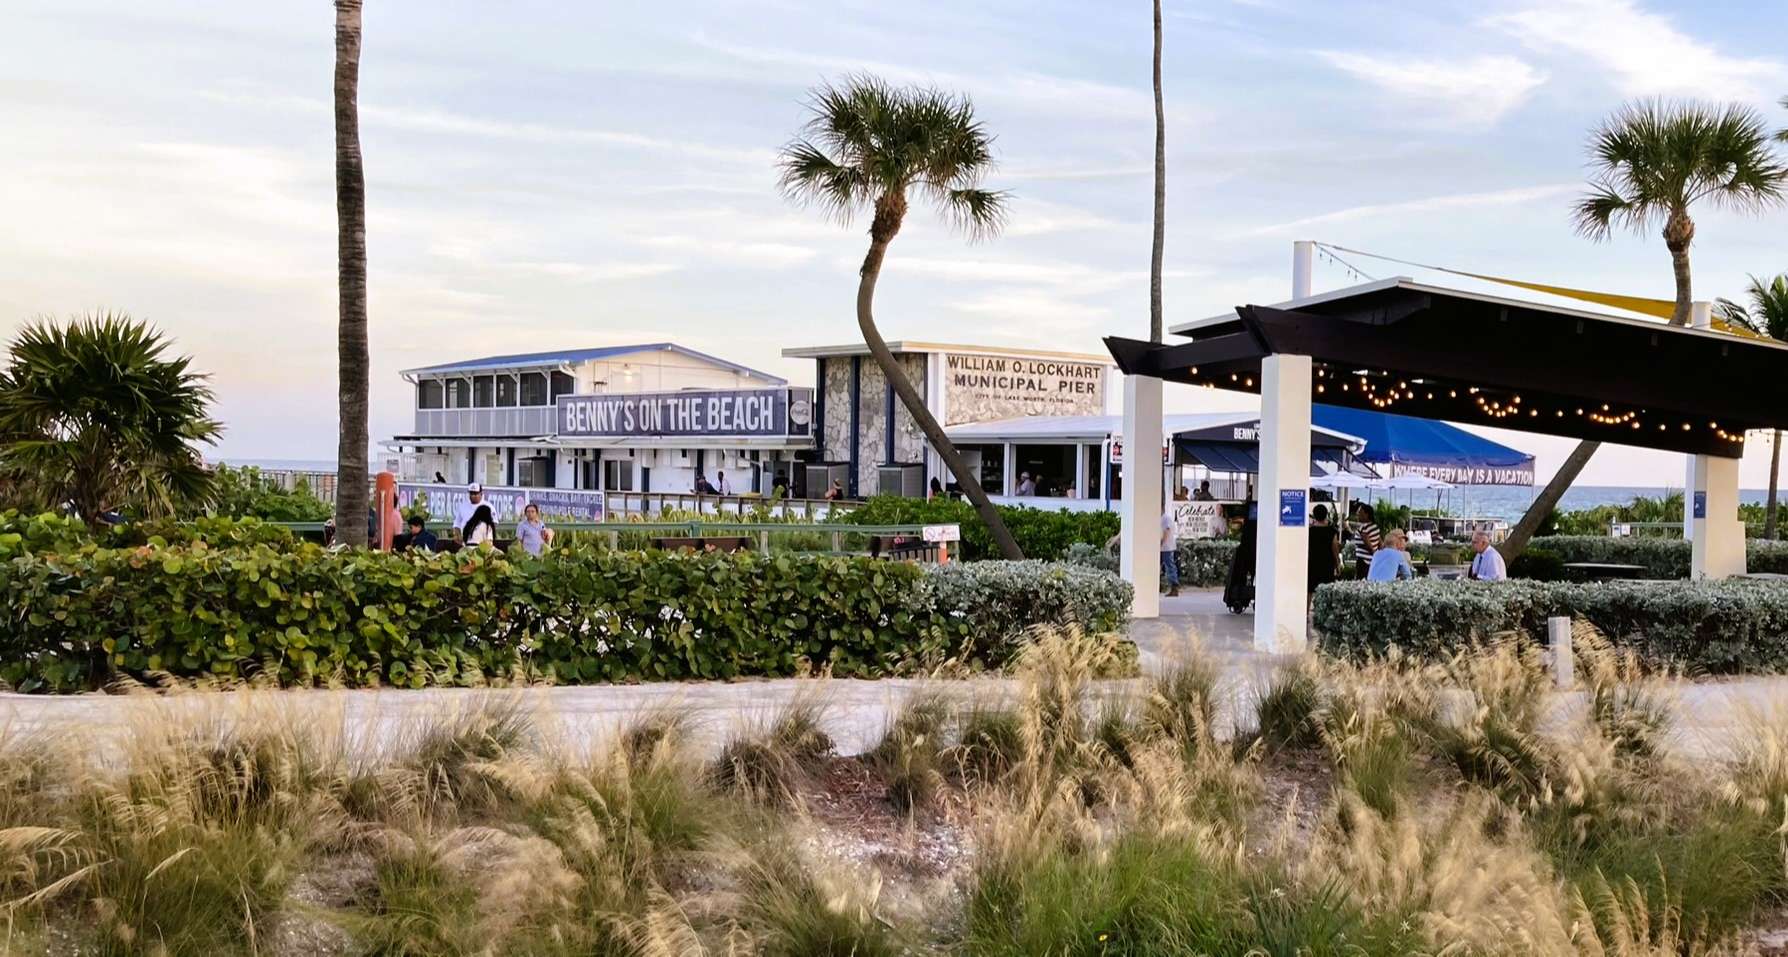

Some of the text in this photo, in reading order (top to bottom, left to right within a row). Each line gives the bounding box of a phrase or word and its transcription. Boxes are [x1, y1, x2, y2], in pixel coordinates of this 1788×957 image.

[947, 356, 1101, 379] WILLIAM O. LOCKHART
[954, 374, 1096, 394] MUNICIPAL PIER
[566, 395, 774, 432] BENNY'S ON THE BEACH
[1429, 467, 1457, 482] EVERY
[1457, 468, 1473, 484] DAY
[1475, 469, 1485, 484] IS
[1485, 469, 1493, 484] A
[1494, 469, 1534, 485] VACATION
